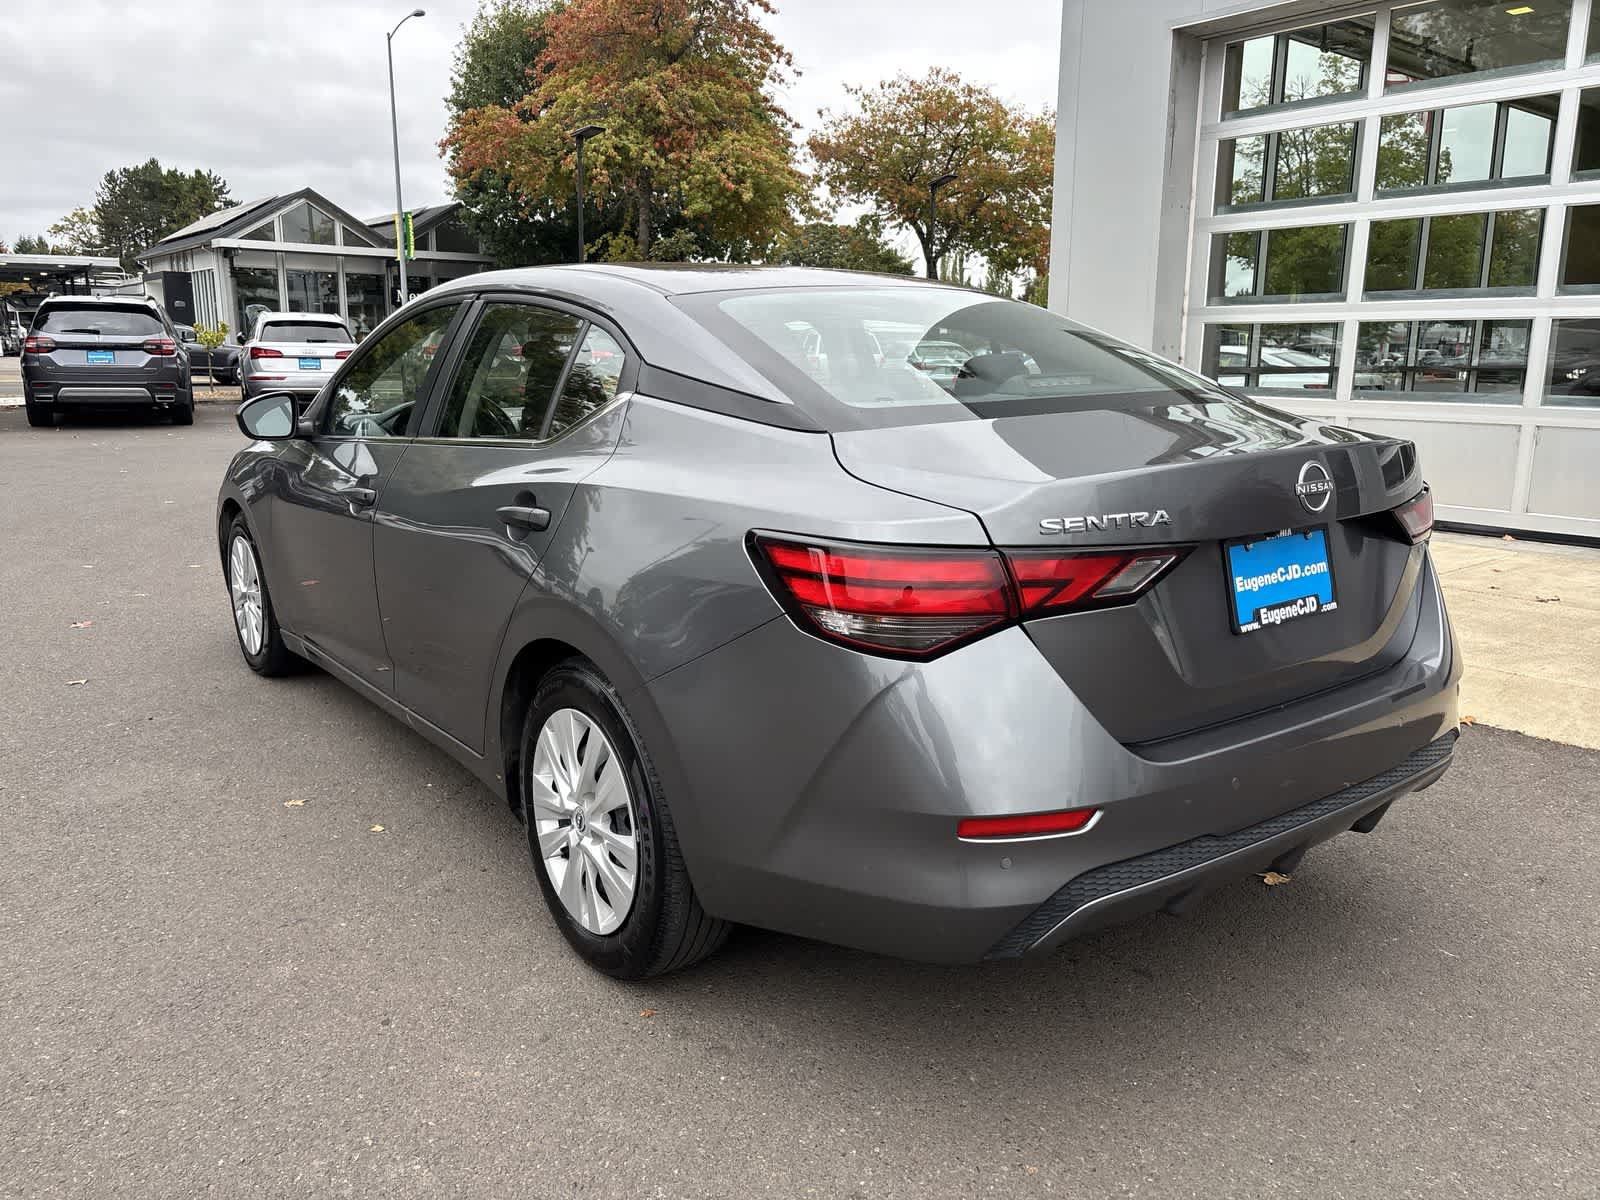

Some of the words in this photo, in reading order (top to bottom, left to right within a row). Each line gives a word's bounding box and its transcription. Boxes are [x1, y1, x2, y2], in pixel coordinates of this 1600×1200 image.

[1297, 481, 1334, 494] NISSAN
[1039, 509, 1172, 535] SENTRA
[1235, 561, 1328, 592] EugeneCJD.com
